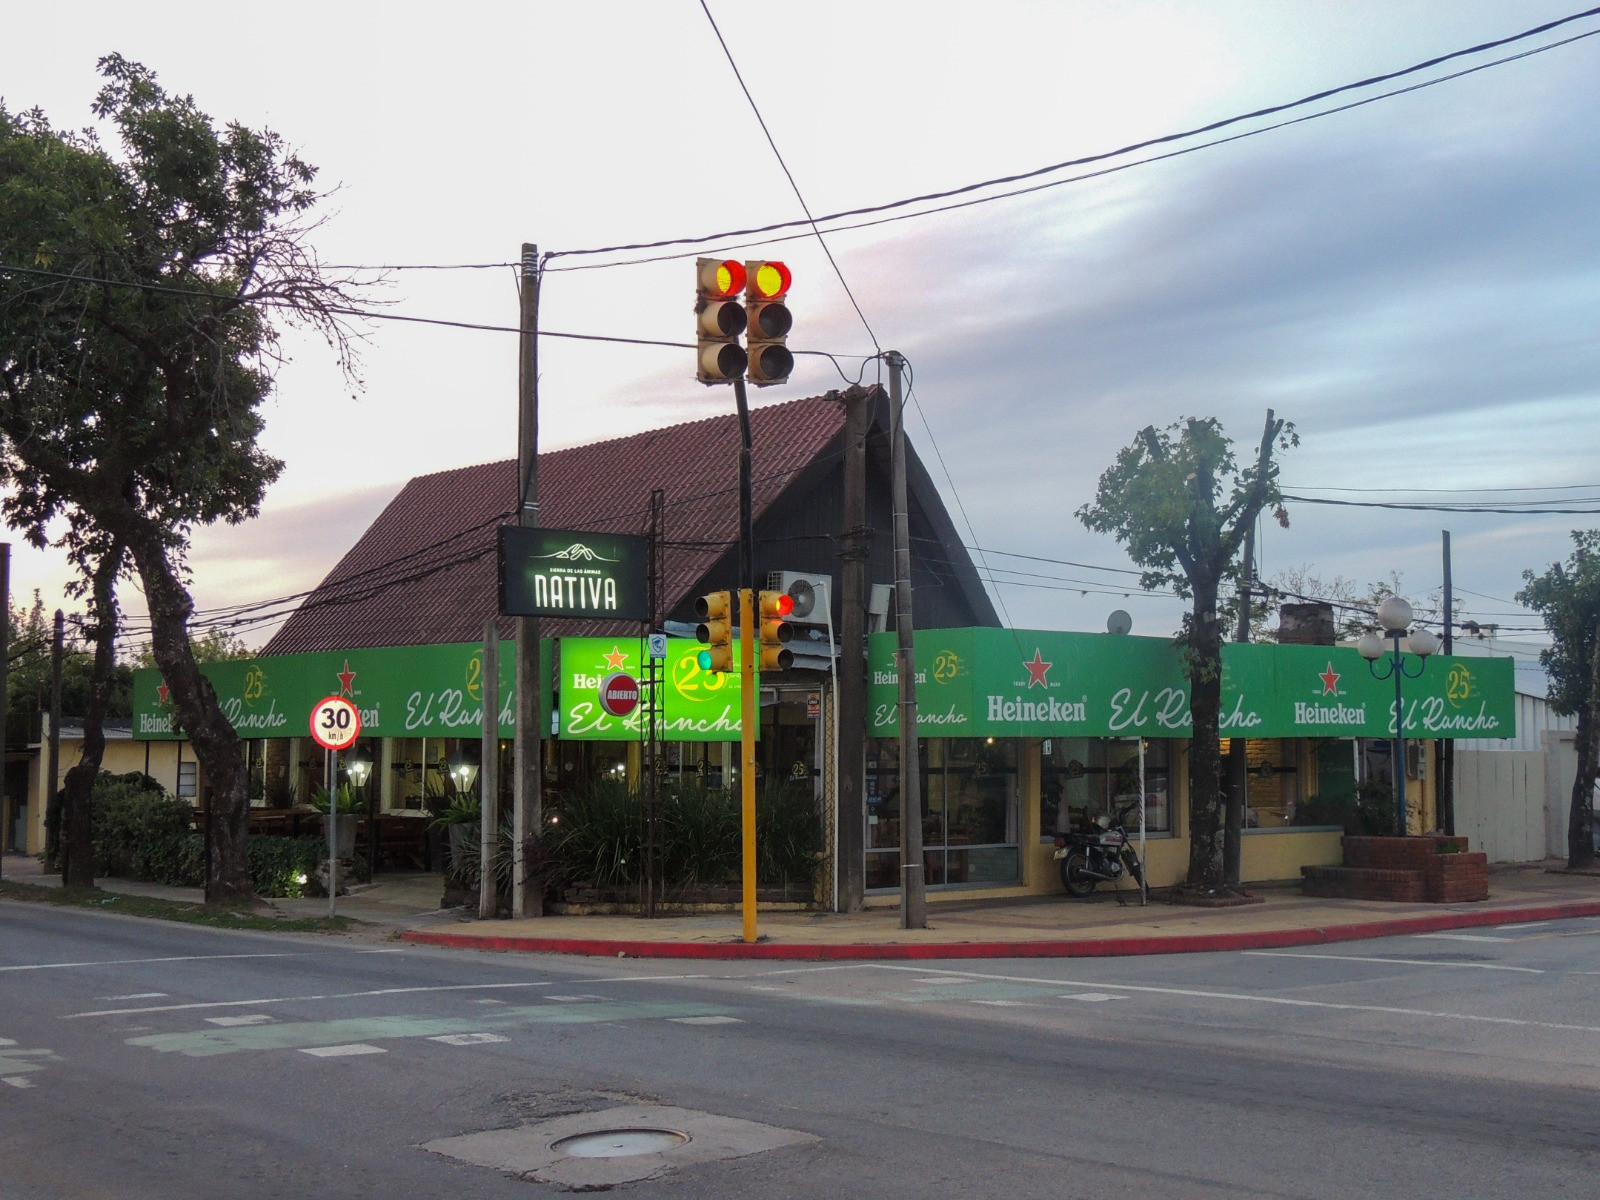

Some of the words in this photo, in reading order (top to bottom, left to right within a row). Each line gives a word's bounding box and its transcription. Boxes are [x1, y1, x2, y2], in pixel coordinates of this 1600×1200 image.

[535, 574, 617, 610] NATIVA
[873, 670, 926, 685] Heinen
[934, 655, 958, 679] 25
[244, 671, 264, 699] 25
[607, 690, 638, 700] ABIERTO
[1448, 670, 1470, 699] 25
[321, 707, 351, 729] 30
[404, 691, 434, 730] El
[874, 704, 897, 727] El
[915, 703, 968, 725] ancho
[1108, 688, 1148, 731] El
[1388, 697, 1418, 734] El
[1421, 696, 1500, 732] Rancho
[328, 731, 344, 742] km/h
